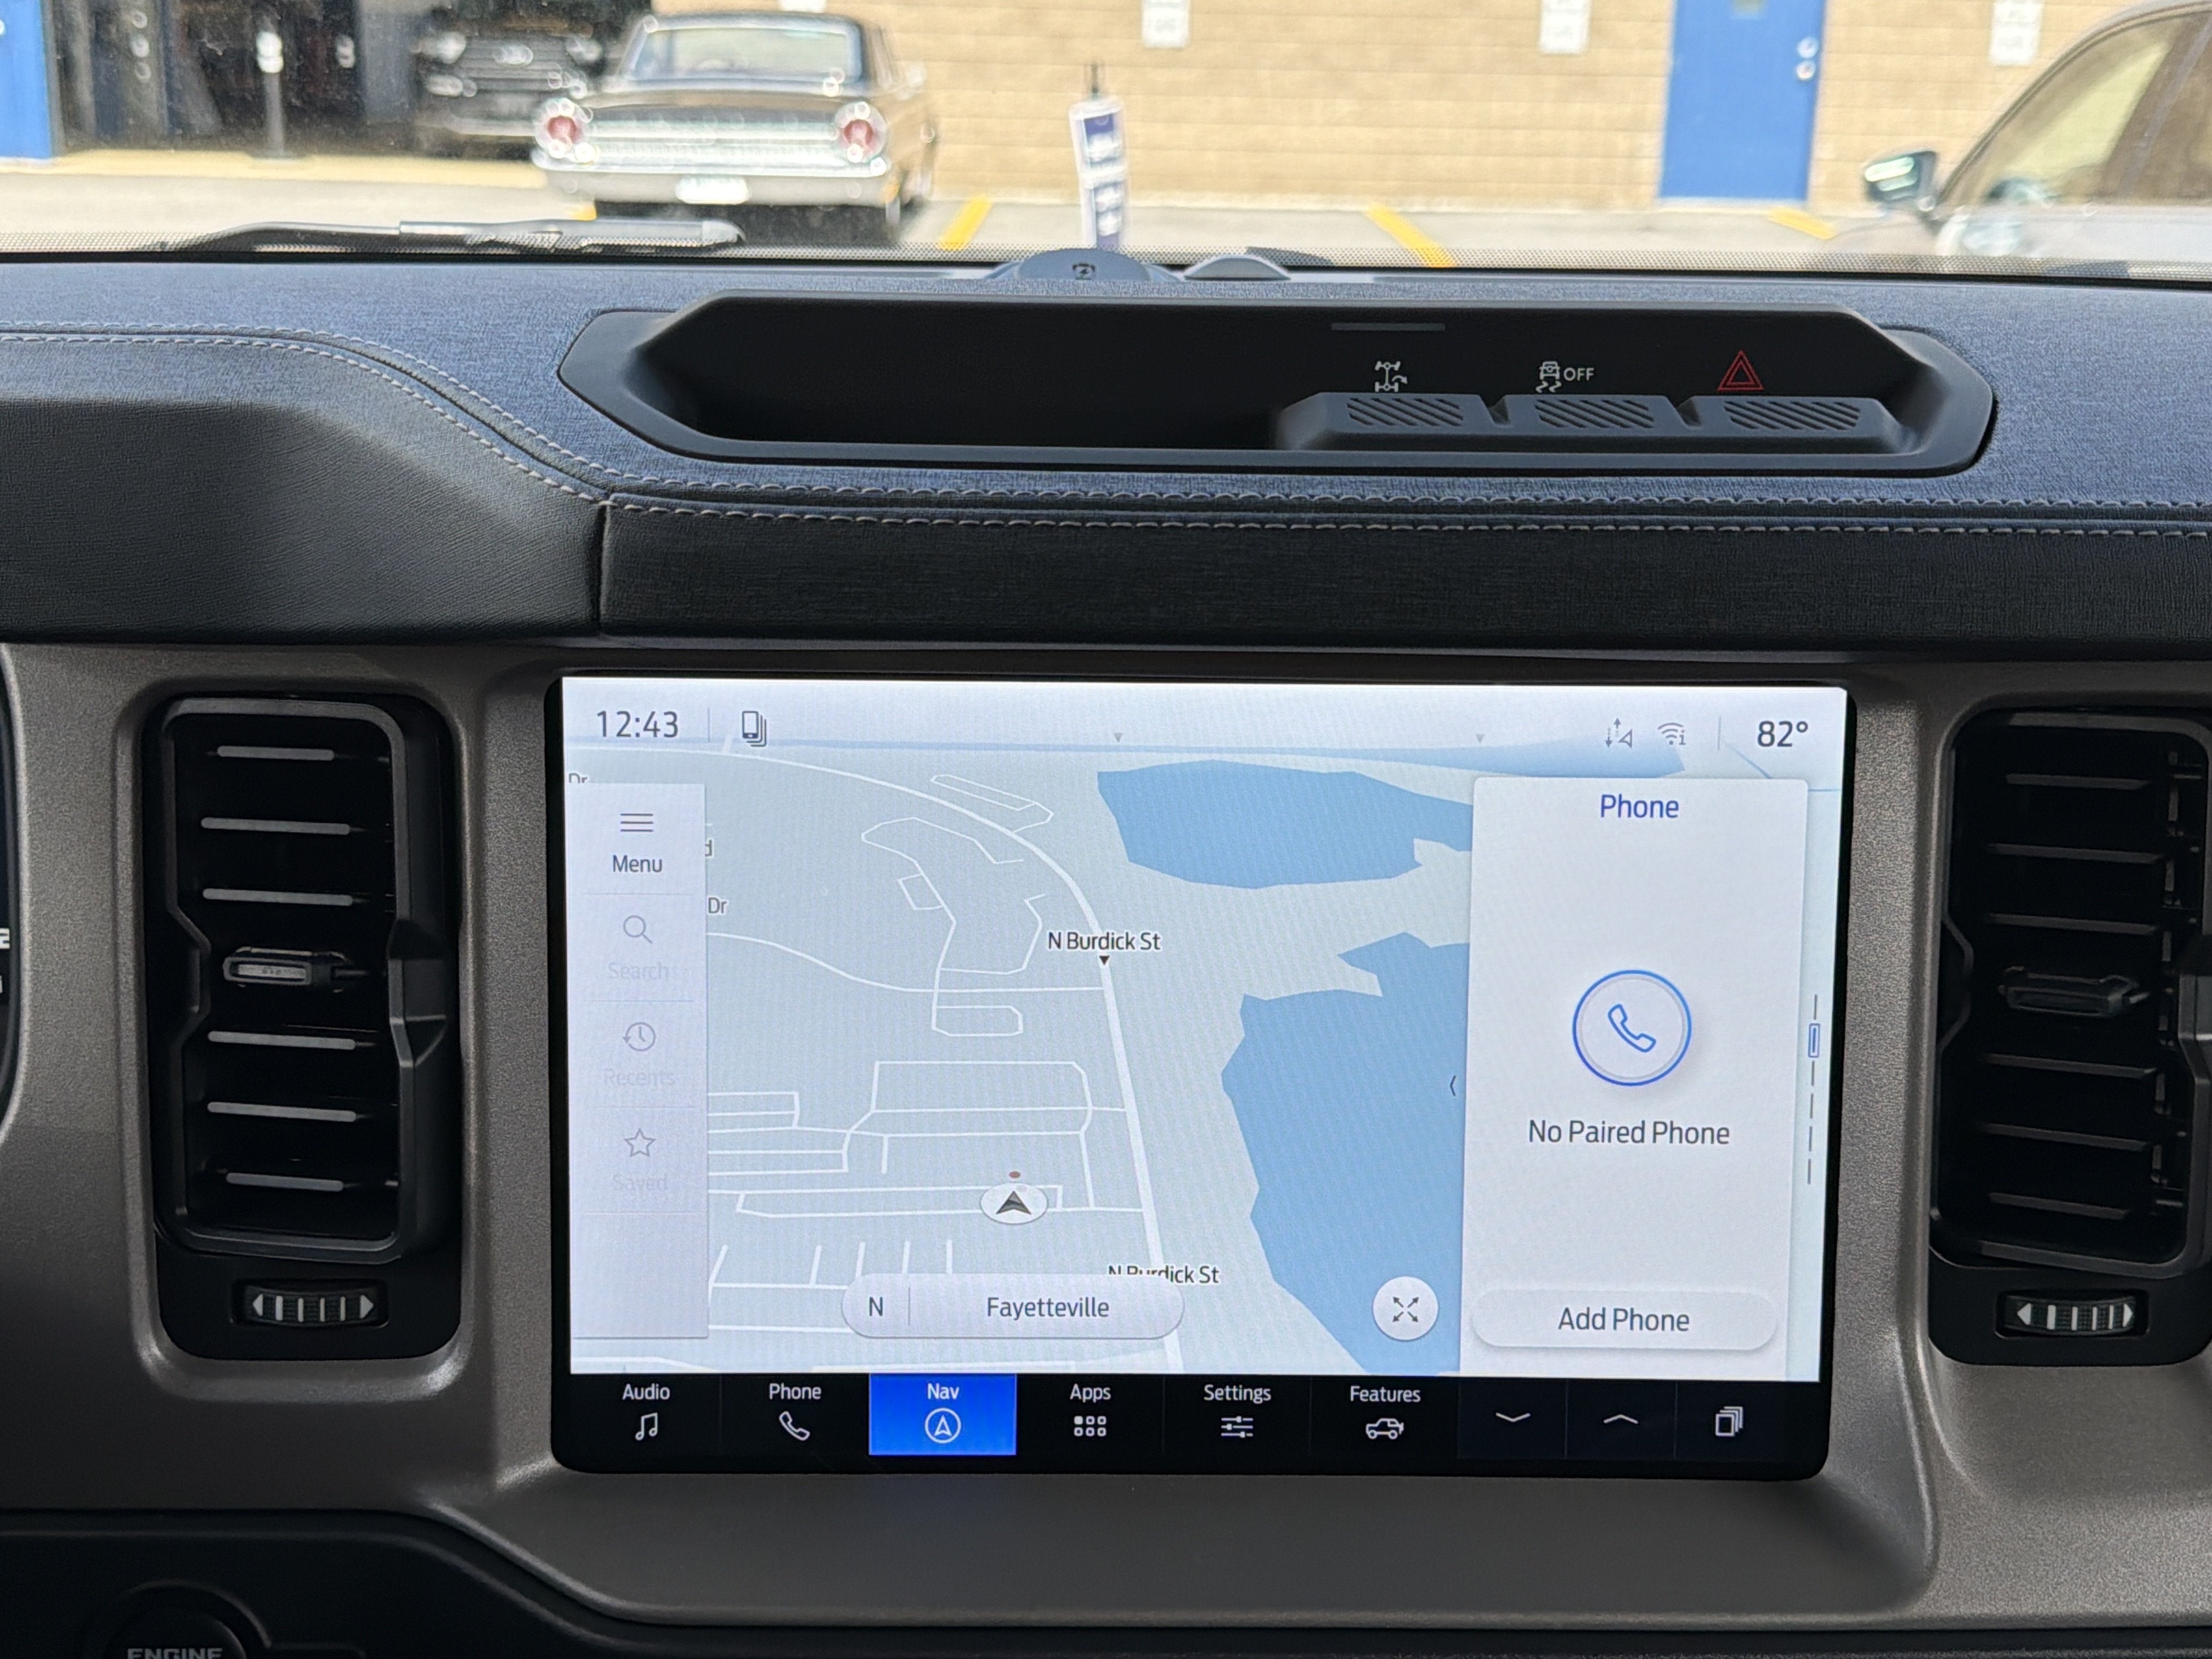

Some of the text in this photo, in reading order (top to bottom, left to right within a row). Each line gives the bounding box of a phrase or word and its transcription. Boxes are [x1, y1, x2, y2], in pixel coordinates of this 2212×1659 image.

[1564, 367, 1594, 381] OFF
[597, 710, 678, 738] 12:43
[1757, 720, 1809, 747] 82°
[1600, 793, 1679, 819] Phone
[612, 855, 663, 872] Menu
[708, 897, 727, 913] Dr
[1048, 932, 1160, 950] N Burdick St
[608, 962, 669, 980] Search
[604, 1069, 675, 1087] Recents
[1529, 1120, 1730, 1144] No Paired Phone
[613, 1175, 668, 1192] Saved
[1199, 1266, 1219, 1284] St
[868, 1297, 883, 1317] N
[987, 1297, 1109, 1321] Fayetteville
[1558, 1307, 1690, 1331] Add Phone
[622, 1383, 670, 1400] Audio
[769, 1383, 822, 1400] Phone
[927, 1383, 959, 1400] Nav
[1070, 1384, 1111, 1403] Apps
[1204, 1385, 1272, 1404] Settings
[1350, 1386, 1421, 1402] Features
[127, 1648, 223, 1659] ENGINE
